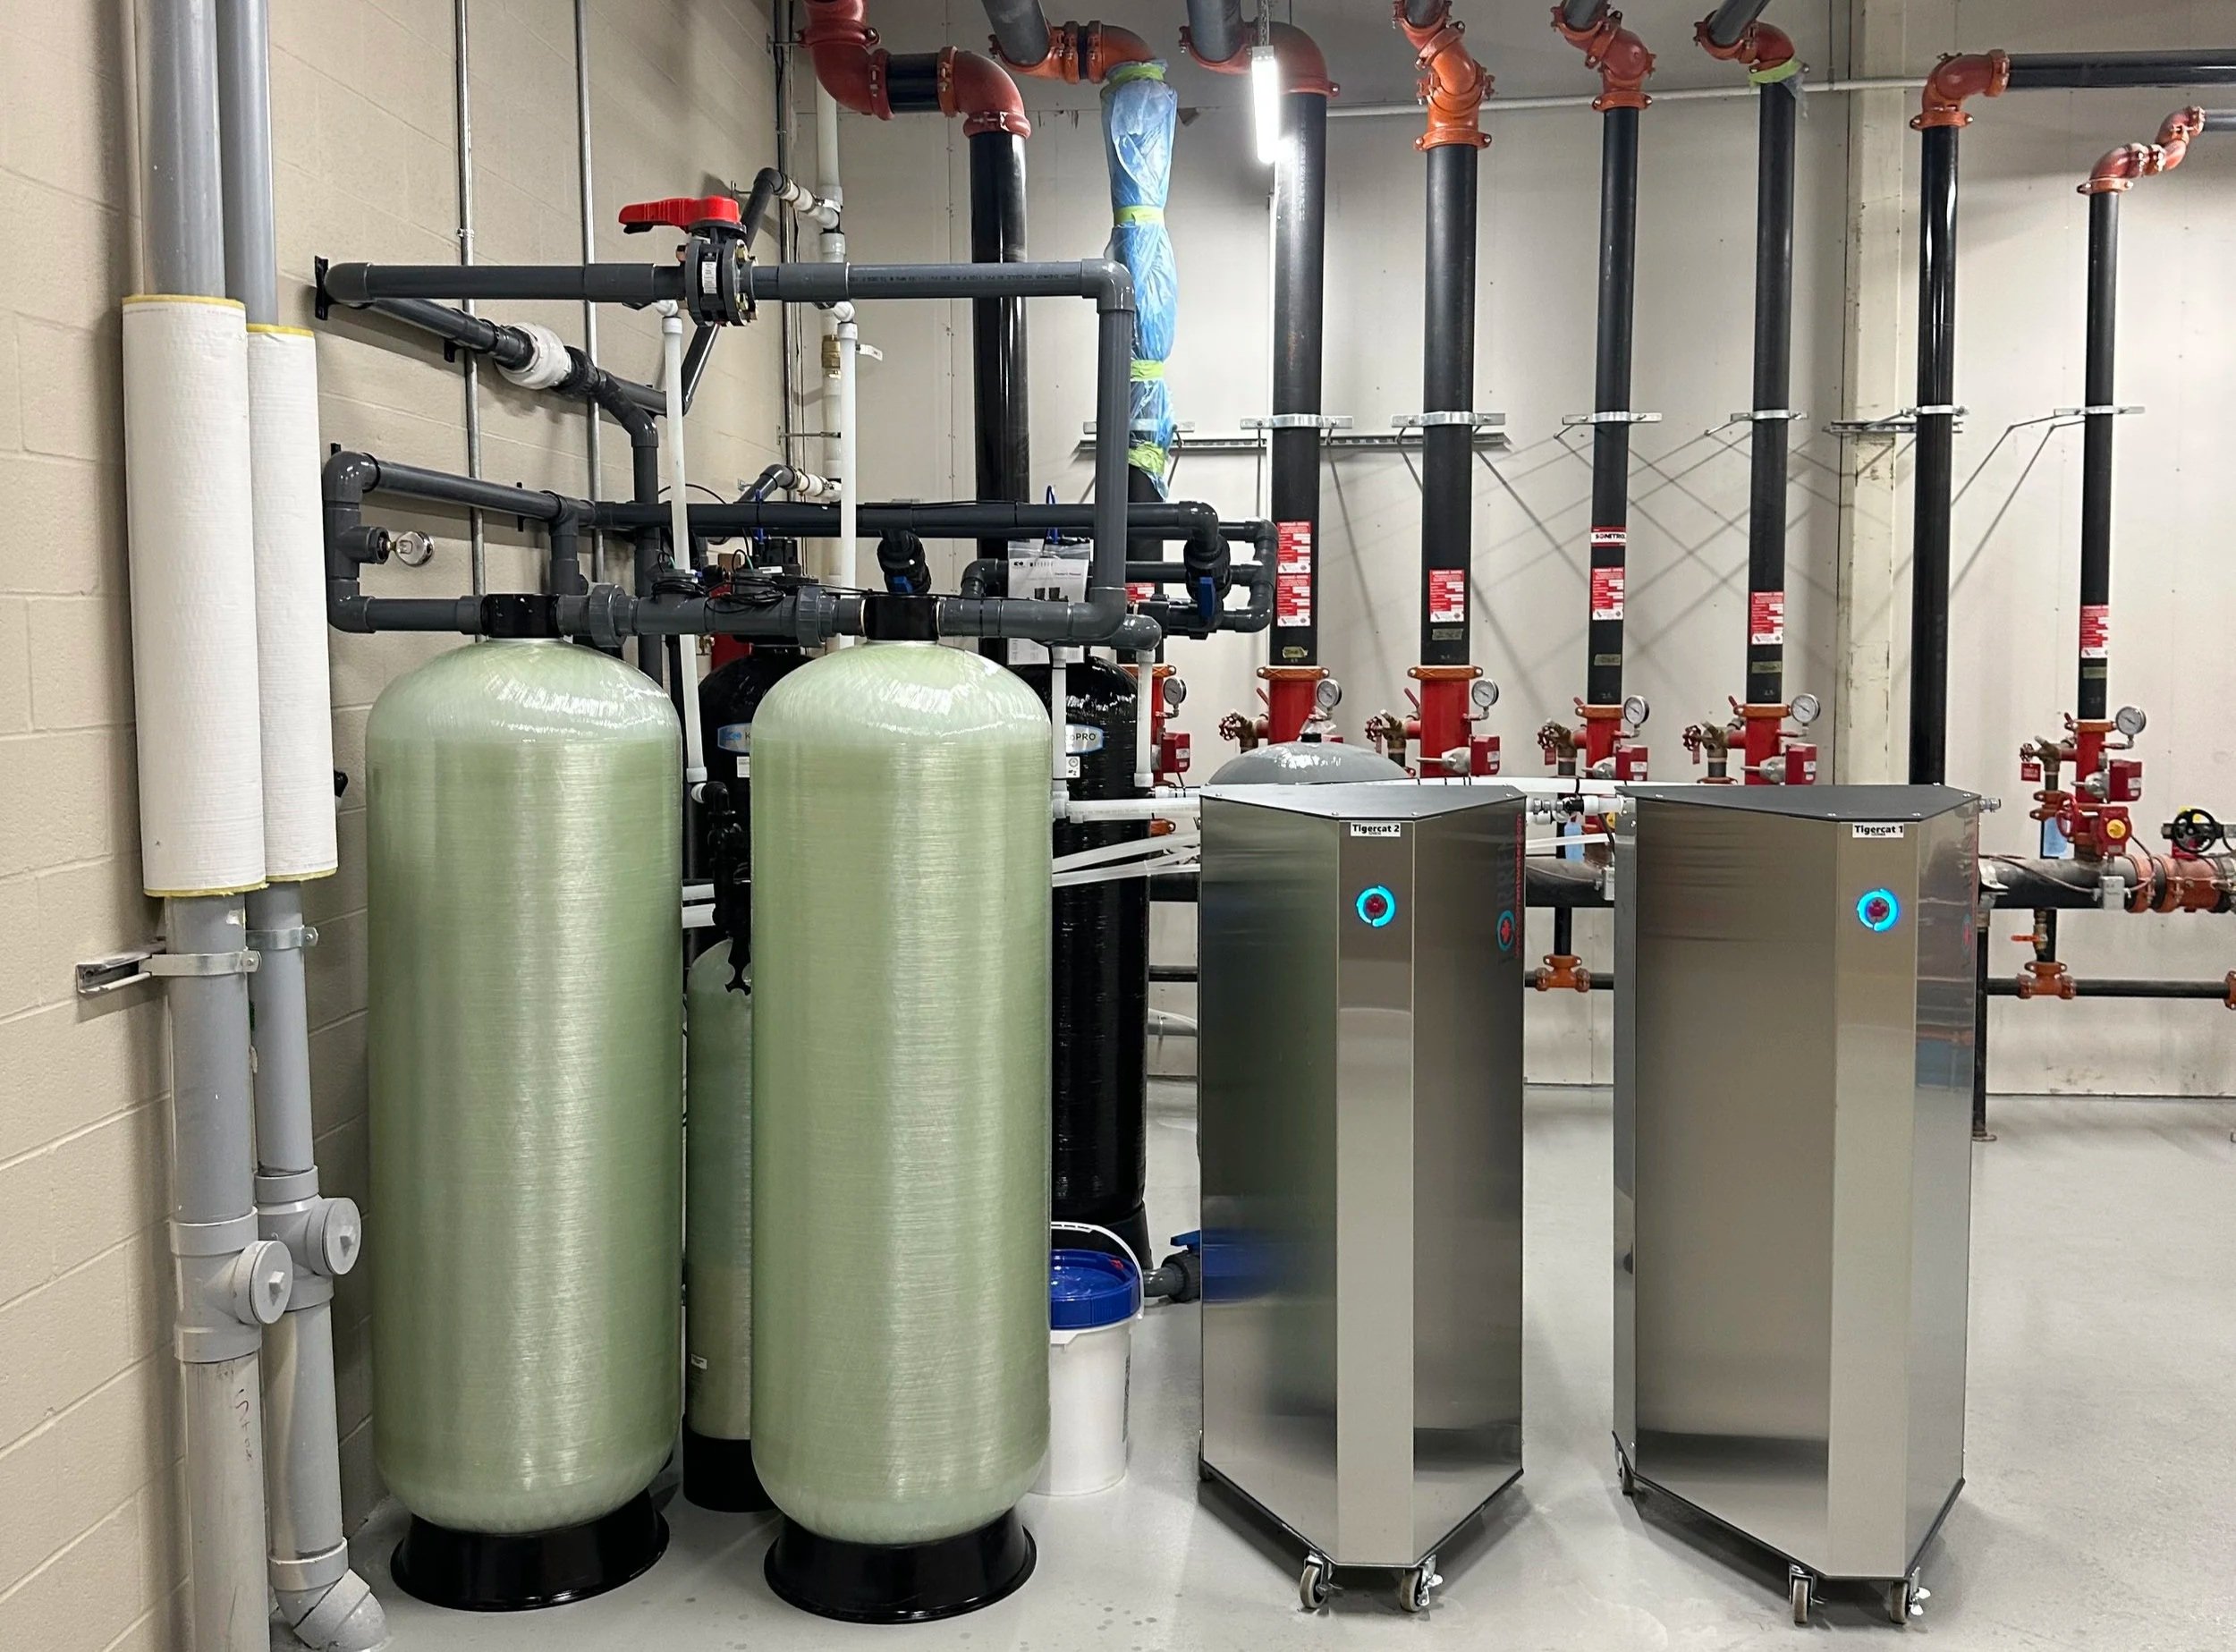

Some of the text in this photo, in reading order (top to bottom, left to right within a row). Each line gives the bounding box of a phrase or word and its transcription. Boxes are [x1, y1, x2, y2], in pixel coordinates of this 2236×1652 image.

[1352, 824, 1392, 834] Tigercat
[1394, 825, 1400, 833] 2
[1854, 825, 1895, 835] Tigercat
